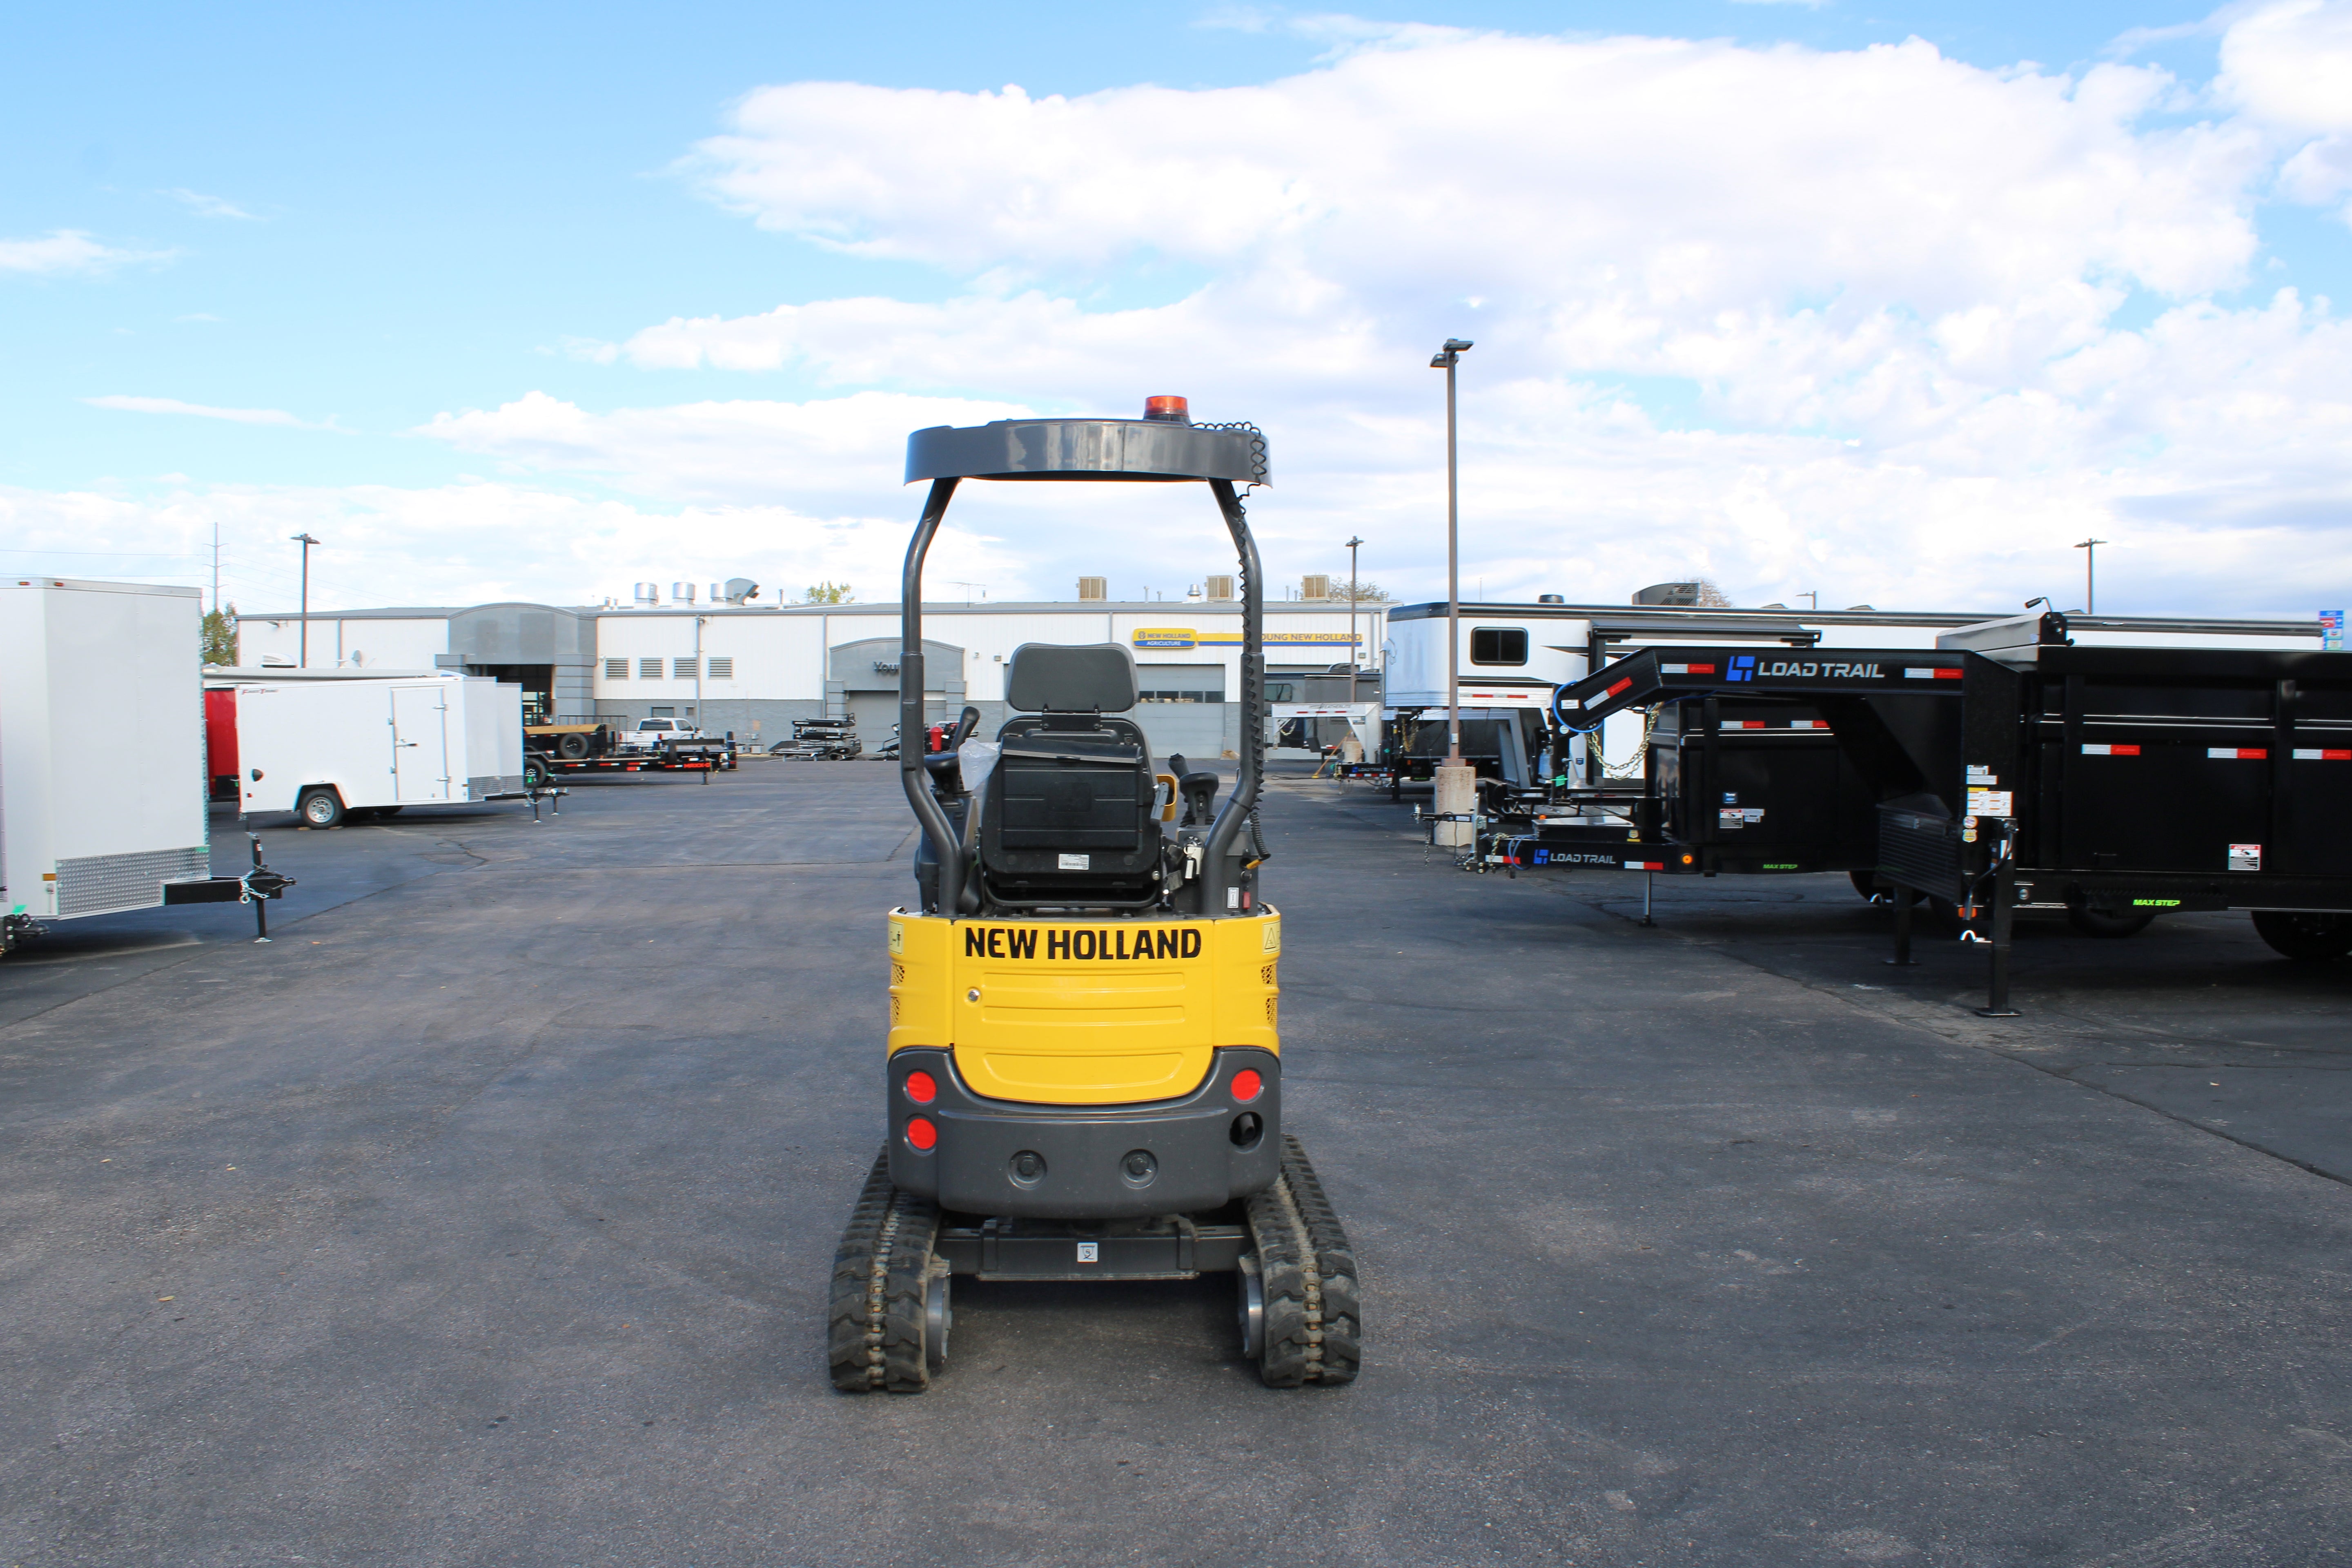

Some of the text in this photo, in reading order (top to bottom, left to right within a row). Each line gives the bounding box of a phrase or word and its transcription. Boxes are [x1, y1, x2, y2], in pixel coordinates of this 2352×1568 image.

[1758, 662, 1885, 678] LOAD TRAIL
[1550, 853, 1616, 864] LOAD TRAIL
[965, 927, 1201, 960] NEW HOLLAND
